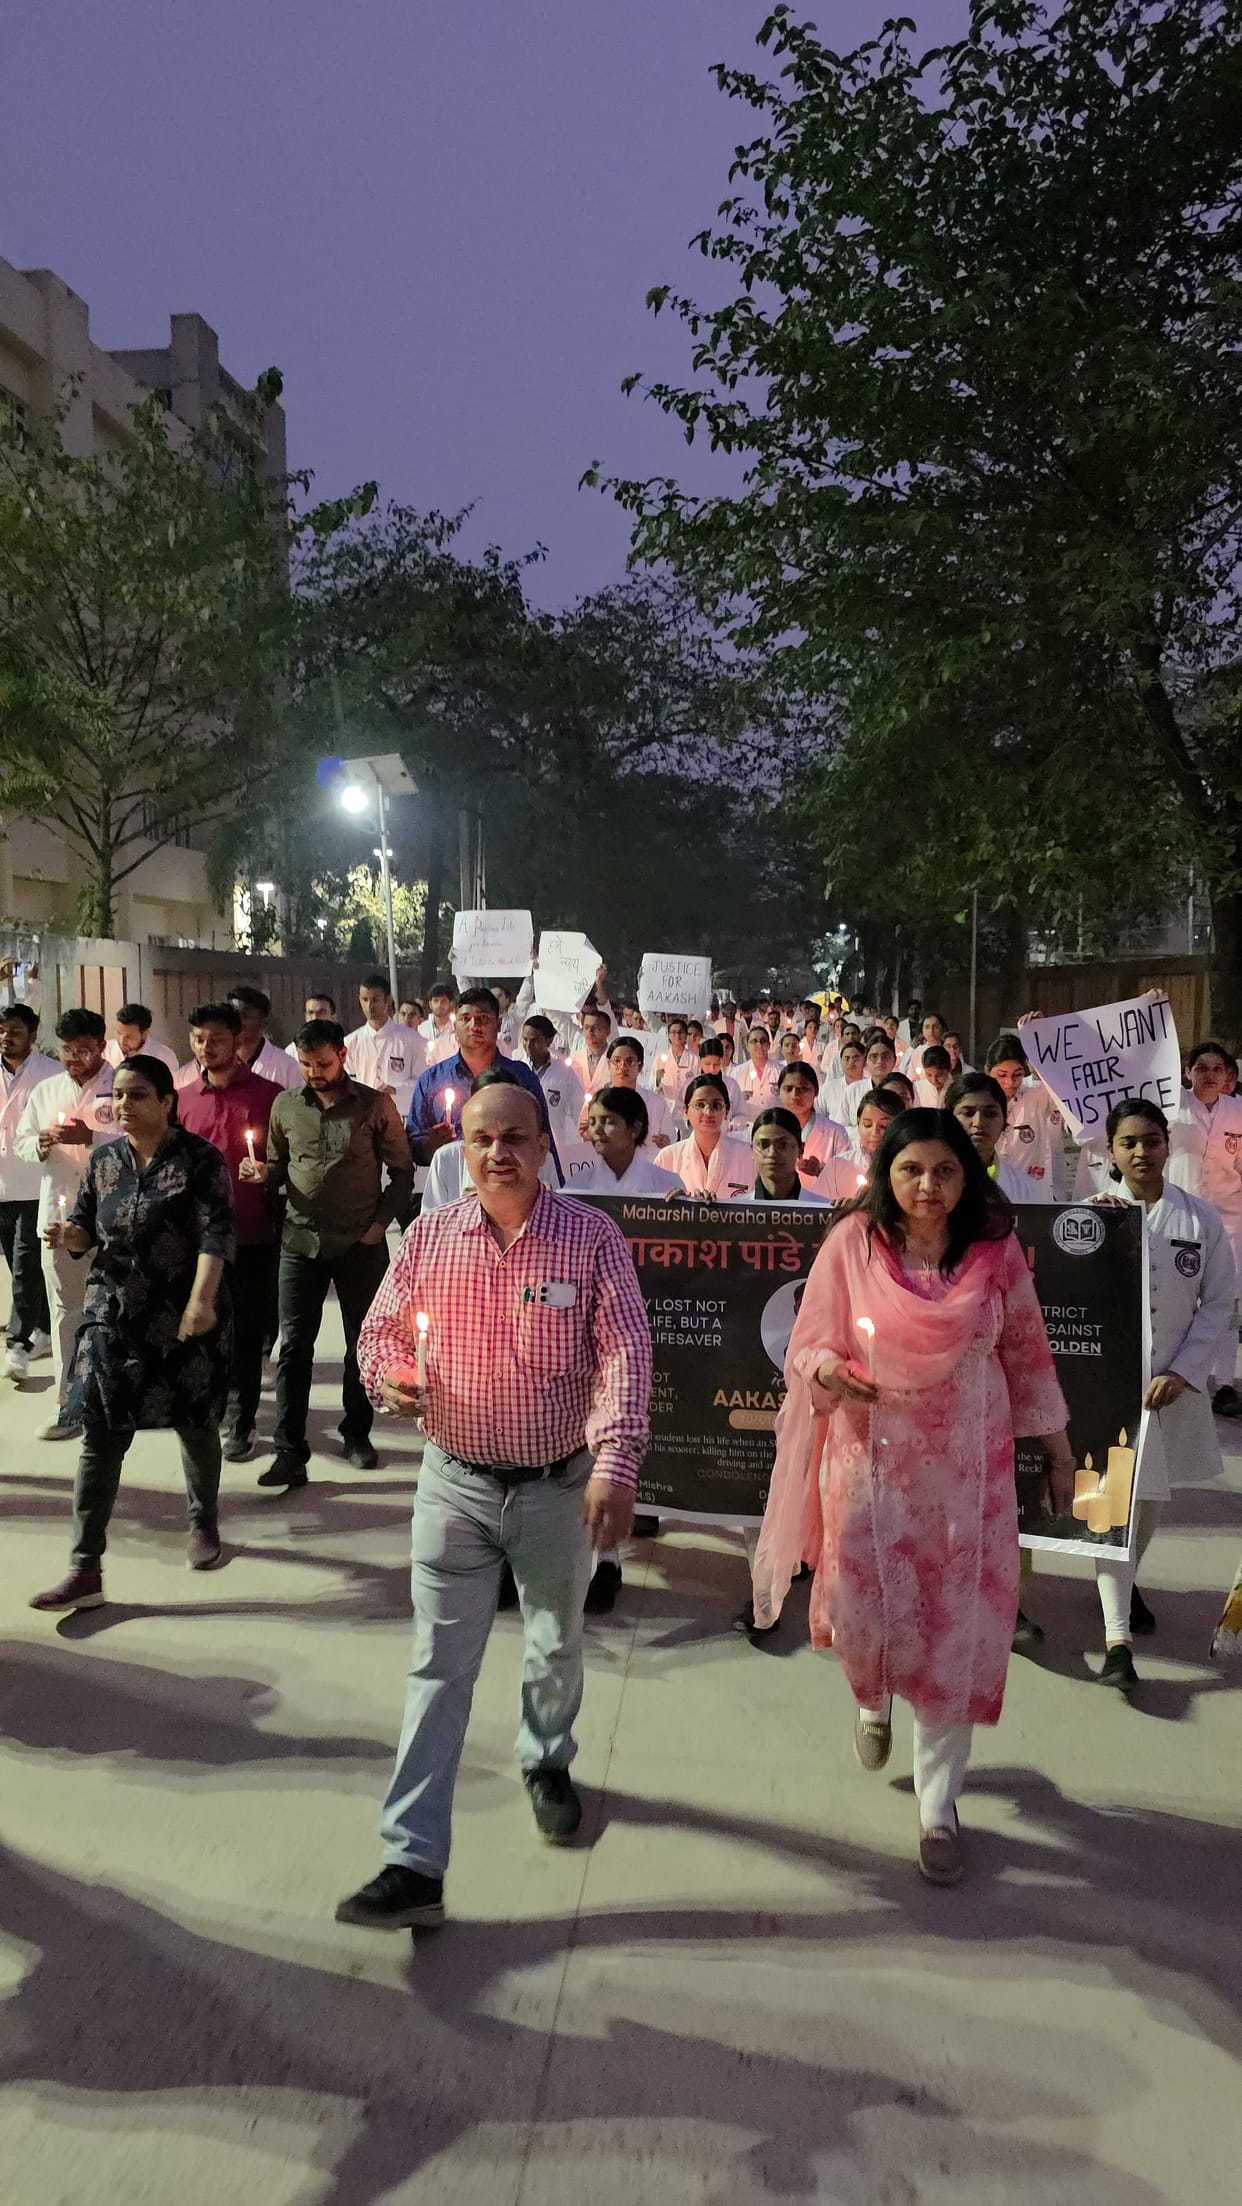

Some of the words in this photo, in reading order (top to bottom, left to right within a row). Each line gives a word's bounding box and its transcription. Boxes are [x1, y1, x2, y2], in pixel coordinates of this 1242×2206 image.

[651, 960, 702, 977] JUSTICE
[662, 974, 682, 990] FOR
[647, 990, 697, 1005] AAKASH
[1033, 1024, 1083, 1064] WE
[1096, 1000, 1169, 1053] WANT
[1071, 1056, 1125, 1091] FAIR
[623, 1204, 694, 1222] Maharshi
[699, 1207, 766, 1225] Devraha
[771, 1210, 813, 1225] Baba
[738, 1231, 804, 1272] पांडे
[655, 1298, 692, 1312] LOST
[695, 1300, 727, 1313] NOT
[1042, 1305, 1088, 1319] TRICT
[680, 1316, 709, 1329] BUT
[712, 1318, 722, 1330] A
[1046, 1323, 1103, 1337] GAINST
[1049, 1340, 1103, 1355] OLDEN
[653, 1372, 670, 1383] OT
[651, 1387, 678, 1400] ENT,
[712, 1389, 787, 1409] AAKAS
[650, 1401, 674, 1413] DER
[655, 1432, 685, 1443] student
[686, 1433, 700, 1444] lost
[703, 1434, 714, 1445] his
[717, 1435, 729, 1447] life
[732, 1436, 755, 1447] when
[756, 1439, 767, 1448] an
[654, 1442, 666, 1452] his
[667, 1445, 700, 1455] scooter,
[702, 1445, 727, 1458] killing
[729, 1447, 745, 1458] him
[747, 1450, 758, 1459] on
[760, 1448, 774, 1459] the
[1018, 1462, 1042, 1473] Reckl
[716, 1458, 747, 1471] driving
[748, 1460, 763, 1470] and
[697, 1468, 769, 1481] CONDOLENC
[638, 1479, 673, 1493] Mishra
